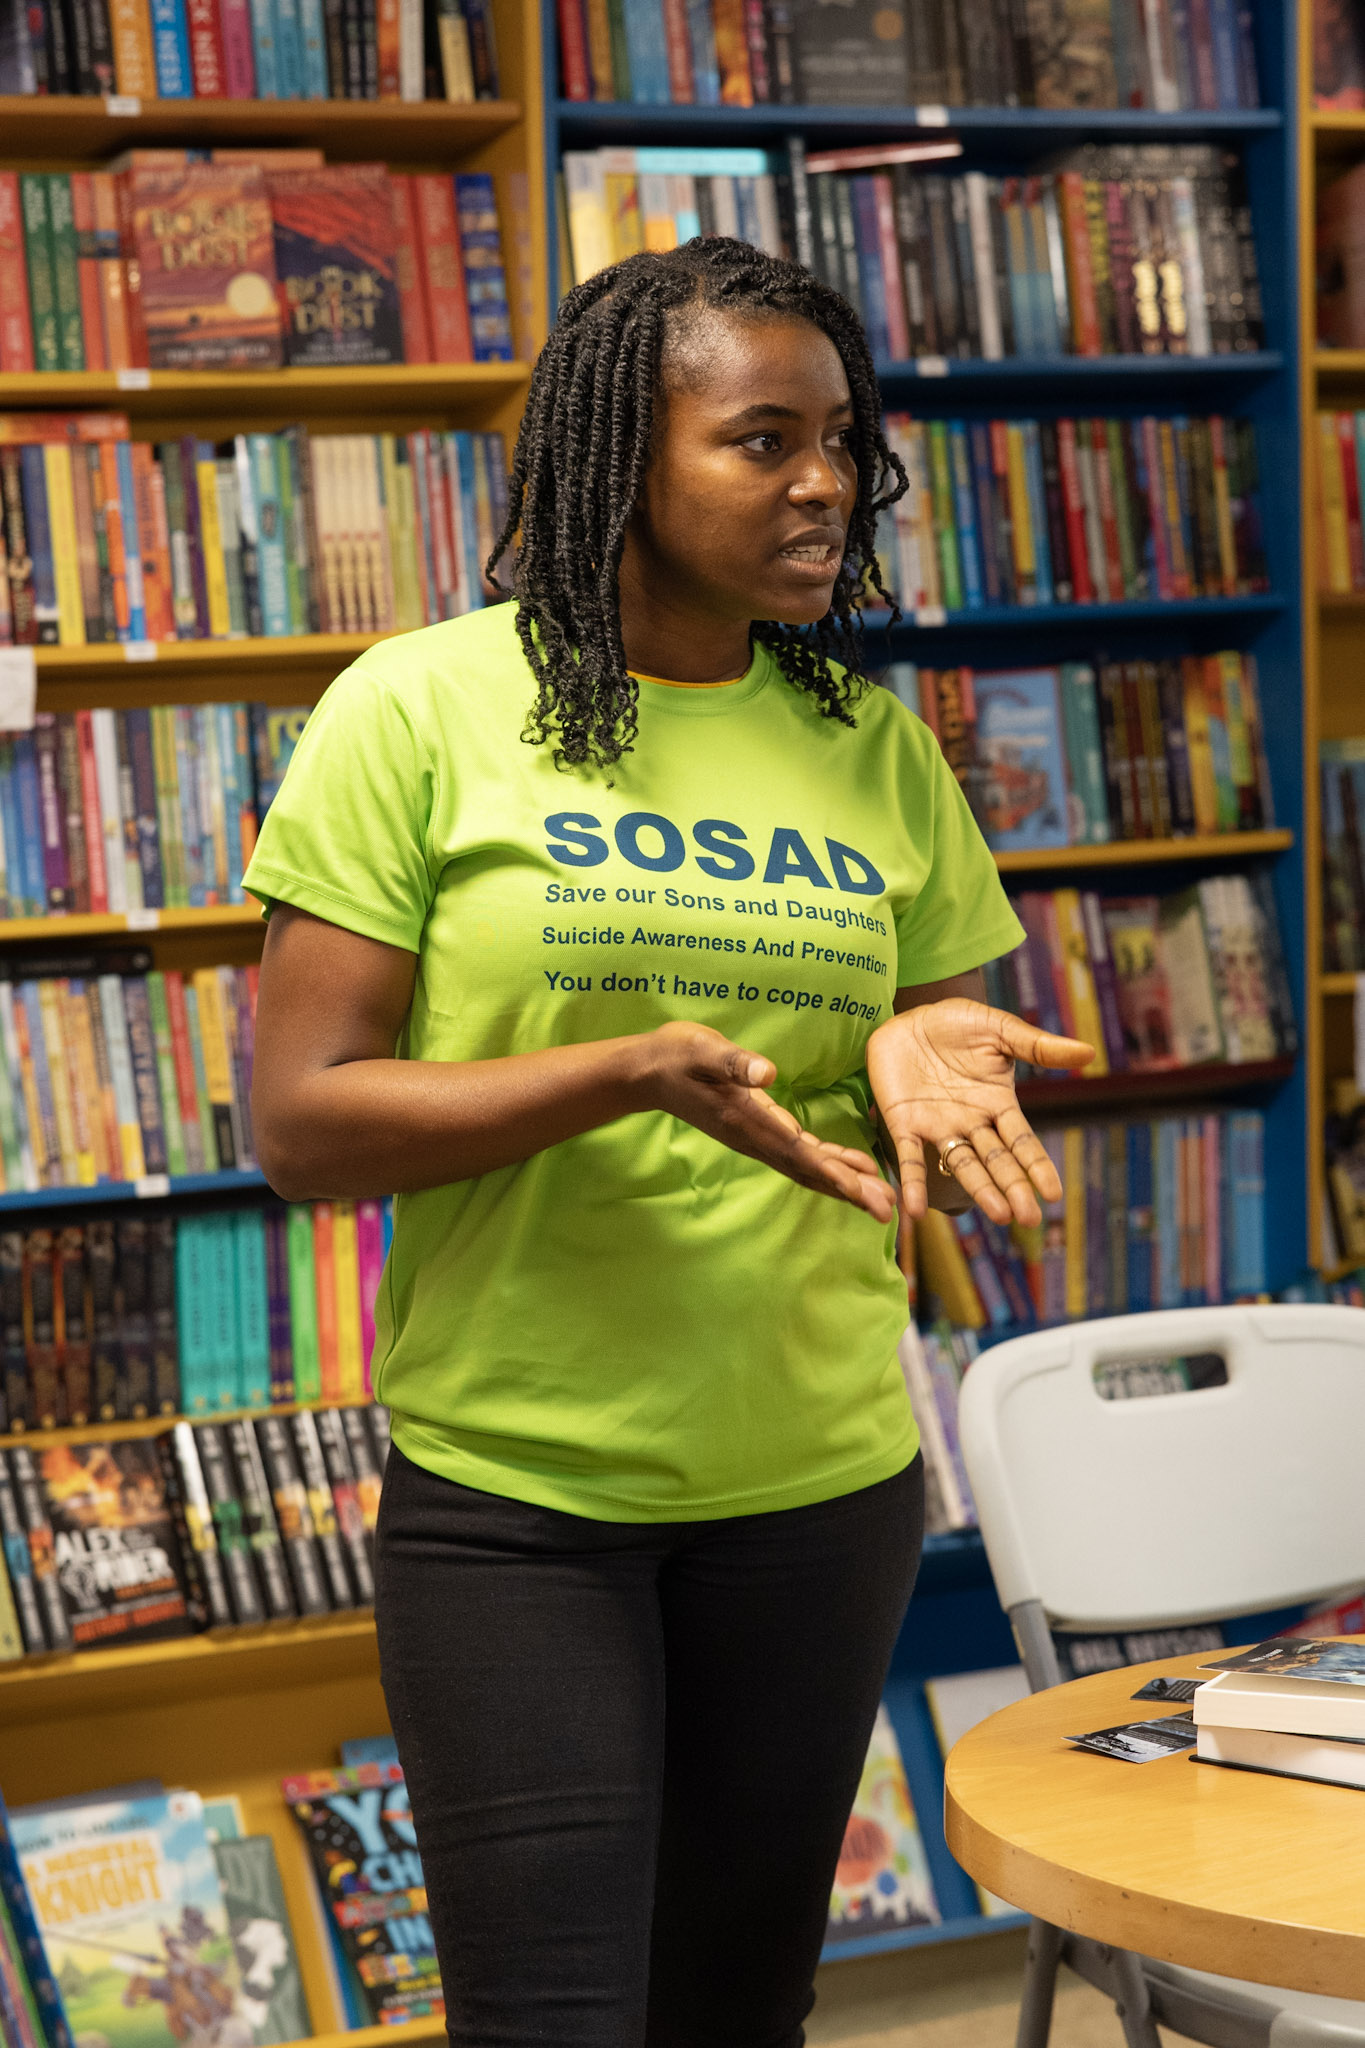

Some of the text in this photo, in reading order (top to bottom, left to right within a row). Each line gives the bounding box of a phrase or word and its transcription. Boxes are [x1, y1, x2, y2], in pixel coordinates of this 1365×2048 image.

[544, 811, 886, 896] SOSAD
[545, 883, 887, 936] Save our Sons and Daughters
[542, 926, 887, 977] Suicide Awareness And Prevention
[544, 970, 882, 1022] You don’t have to cope alone!
[56, 1527, 124, 1565] ALEX
[31, 1859, 162, 1926] KNIGHT
